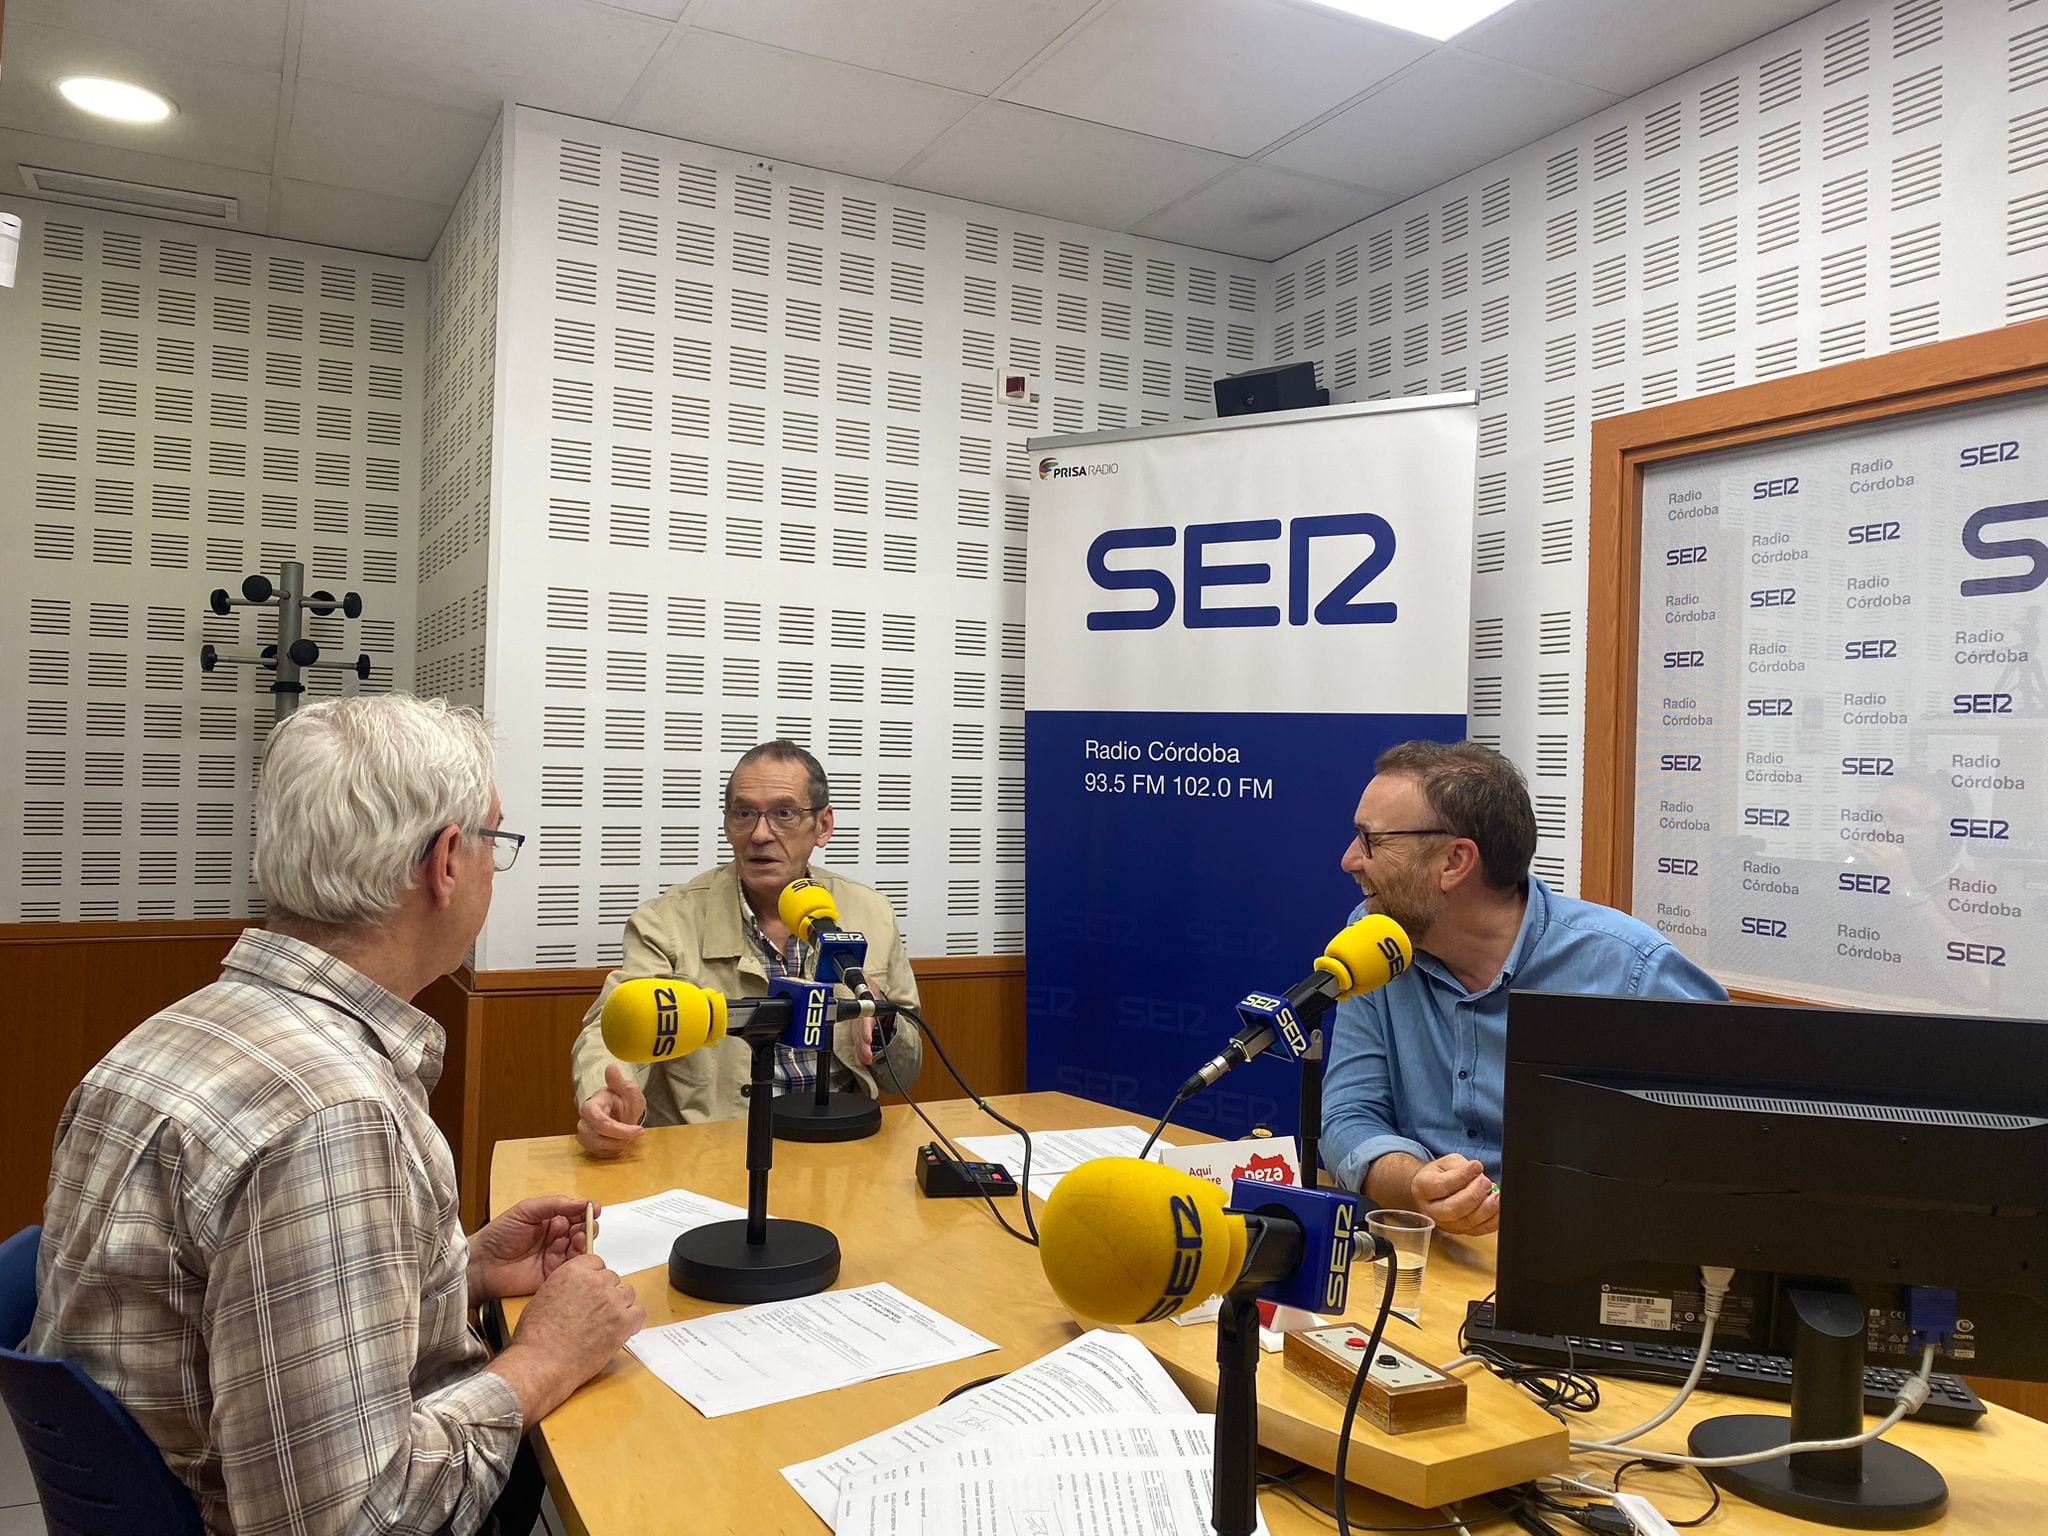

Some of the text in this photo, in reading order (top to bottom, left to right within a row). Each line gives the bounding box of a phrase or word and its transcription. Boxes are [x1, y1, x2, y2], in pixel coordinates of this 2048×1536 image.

[1960, 441, 2020, 468] SER
[1850, 458, 1893, 475] Radio
[1753, 477, 1800, 500] SER
[1850, 474, 1915, 494] Córdoba
[1668, 489, 1702, 504] Radio
[1668, 504, 1719, 521] Córdoba
[1752, 532, 1790, 547] Radio
[1848, 521, 1901, 545] SER
[1666, 546, 1708, 566] SER
[1751, 547, 1809, 565] Córdoba
[1086, 512, 1398, 631] SER
[1847, 575, 1889, 590] Radio
[1665, 594, 1700, 607] Radio
[1750, 588, 1796, 607] SER
[1847, 593, 1911, 609] Córdoba
[1665, 609, 1716, 624] Córdoba
[1955, 630, 2004, 644] Radio
[1749, 642, 1786, 655] Radio
[1845, 639, 1897, 659] SER
[1955, 648, 2029, 664] Córdoba
[1663, 650, 1704, 668] SER
[1749, 660, 1805, 673] Córdoba
[1663, 698, 1697, 710] Radio
[1747, 699, 1793, 716] SER
[1844, 693, 1886, 706] Radio
[1953, 693, 2013, 714] SER
[1662, 714, 1713, 727] Córdoba
[1843, 712, 1908, 725] Córdoba
[1085, 740, 1240, 764] Radio Córdoba
[1746, 752, 1783, 765] Radio
[1660, 755, 1702, 771] SER
[1841, 757, 1894, 776] SER
[1952, 755, 2000, 769] Radio
[1746, 769, 1802, 783] Córdoba
[1951, 775, 2025, 790] Córdoba
[1084, 774, 1273, 799] 93.5 FM 102.0 FM
[1660, 801, 1694, 814] Radio
[1841, 809, 1883, 823] Radio
[1659, 818, 1710, 832] Córdoba
[1744, 808, 1790, 827] SER
[1840, 828, 1905, 844] Córdoba
[1950, 818, 2009, 839] SER
[1658, 858, 1699, 876] SER
[1743, 861, 1780, 875] Radio
[791, 879, 827, 892] SE
[1742, 879, 1800, 895] Córdoba
[1838, 873, 1891, 895] SER
[1949, 878, 1997, 895] Radio
[1657, 903, 1691, 918] Radio
[1948, 898, 2022, 918] Córdoba
[1656, 920, 1708, 937] Córdoba
[1741, 917, 1787, 938] SER
[1837, 925, 1880, 941] Radio
[822, 932, 866, 942] SER
[1376, 936, 1405, 980] SE
[1837, 943, 1902, 963] Córdoba
[1946, 941, 2006, 967] SER
[1241, 994, 1281, 1012] SER
[653, 986, 679, 1057] SER
[804, 988, 826, 1046] SER
[1275, 1007, 1307, 1057] SER
[1135, 1194, 1203, 1324] SER
[1326, 1203, 1354, 1309] SER
